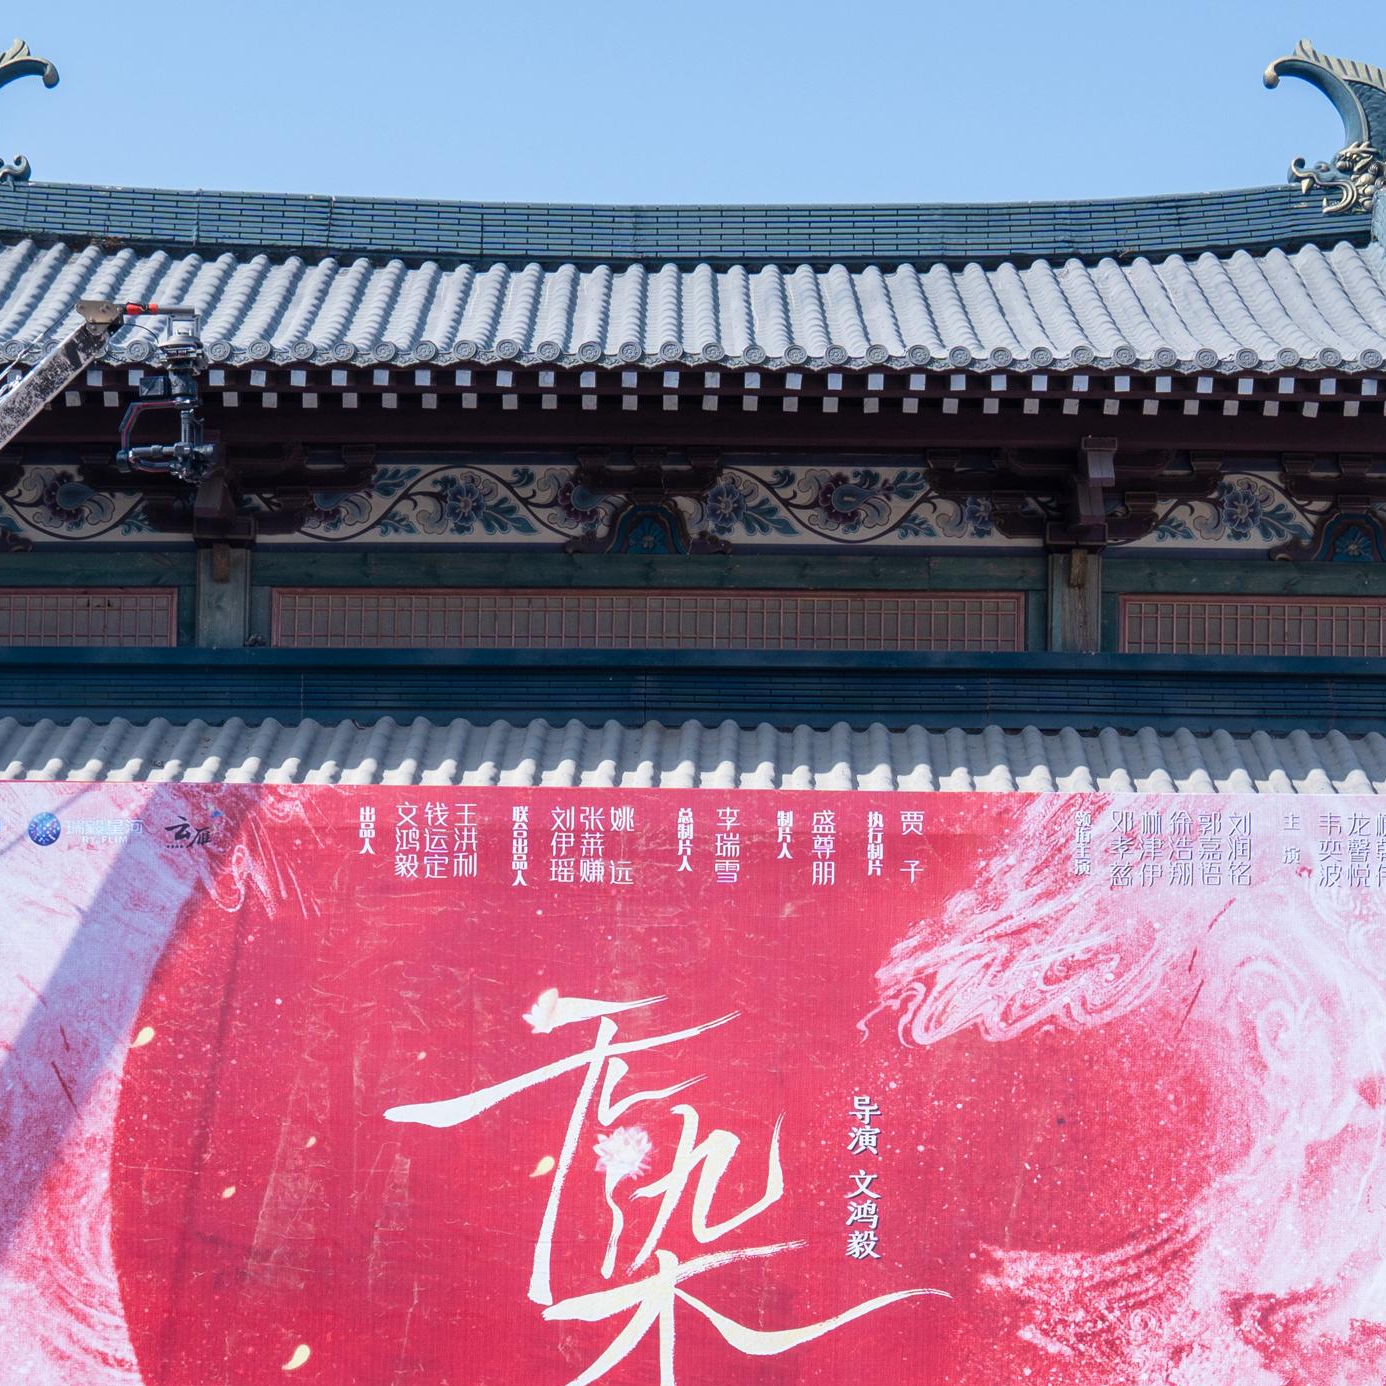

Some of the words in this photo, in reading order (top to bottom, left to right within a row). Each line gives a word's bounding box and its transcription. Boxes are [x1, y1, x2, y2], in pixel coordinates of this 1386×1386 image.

[359, 805, 376, 855] 出品人
[394, 801, 420, 878] 文鸿毅
[423, 801, 449, 878] 钱运定
[453, 803, 478, 878] 王洪利
[512, 806, 528, 887] 联合出品人
[549, 805, 575, 883] 刘伊瑶
[677, 807, 694, 872] 总制片人
[714, 806, 740, 883] 李瑞雪
[777, 810, 793, 859] 制片人
[811, 809, 836, 885] 盛尊朋
[867, 810, 884, 876] 执行制片
[1139, 811, 1163, 887] 林津伊
[1198, 811, 1222, 887] 郭嘉语
[1227, 811, 1252, 887] 刘润铭
[1317, 811, 1343, 888] 韦奕波
[845, 1095, 882, 1156] 导演
[844, 1169, 882, 1260] 文鸿毅
